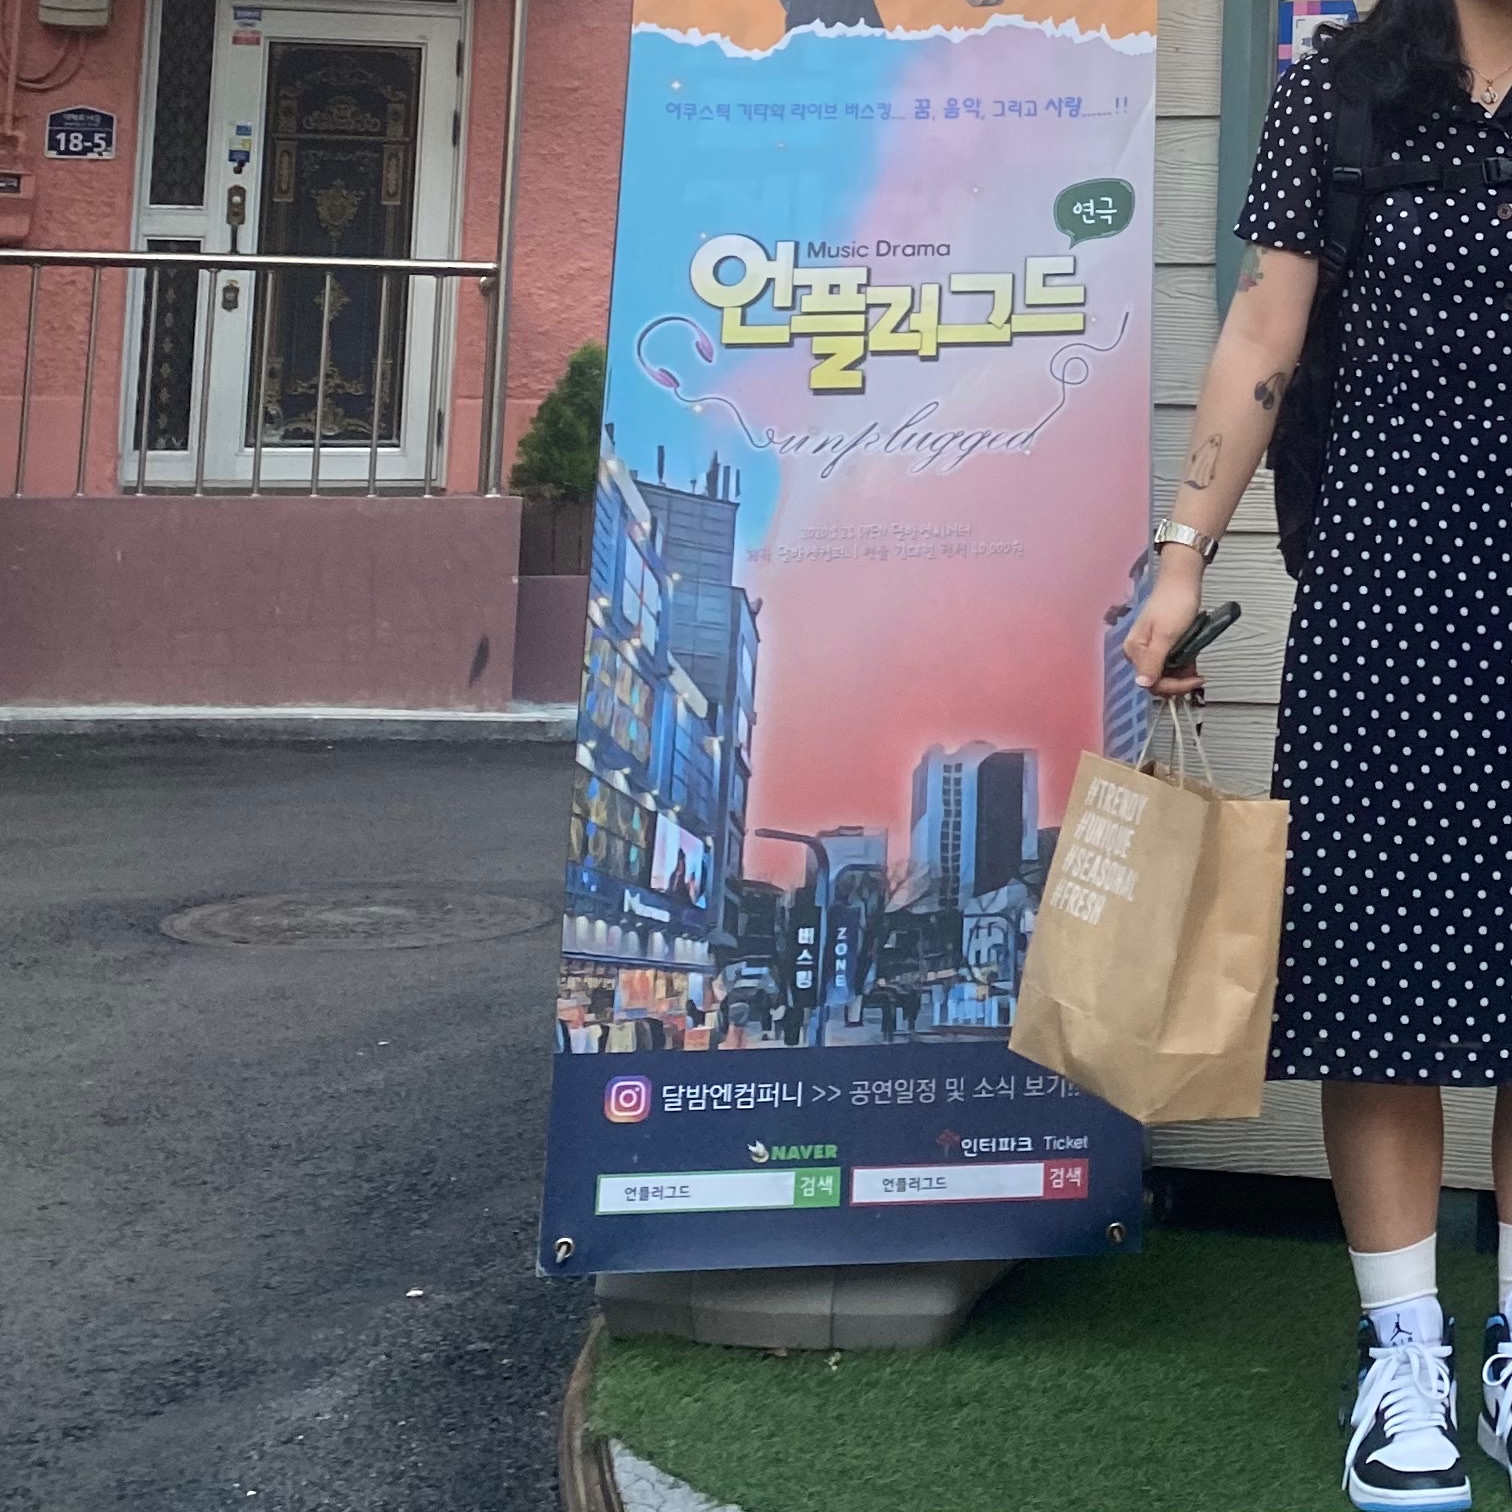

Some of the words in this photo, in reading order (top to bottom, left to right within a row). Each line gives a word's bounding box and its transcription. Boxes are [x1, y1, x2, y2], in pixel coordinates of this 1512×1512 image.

[665, 102, 731, 121] 어쿠스틱
[738, 102, 786, 121] 기타와
[790, 102, 838, 121] 라이브
[943, 97, 985, 121] 음악,
[992, 99, 1038, 119] 그리고
[56, 132, 107, 153] 18-5
[1072, 197, 1118, 225] 연극
[807, 240, 870, 258] Music
[875, 239, 951, 258] Drama
[690, 233, 1086, 393] 언플러그드
[766, 401, 1036, 478] unplugged
[796, 927, 815, 989] 버스킹
[834, 927, 848, 987] ZONE
[661, 1082, 803, 1112] 달밤엔컴퍼니
[849, 1078, 936, 1106] 공연일정
[945, 1076, 965, 1102] 및
[972, 1075, 1015, 1100] 소식
[771, 1143, 838, 1161] NAVER
[961, 1136, 1033, 1158] 인터파크
[1043, 1136, 1089, 1151] Ticket
[801, 1176, 833, 1198] 검색
[1050, 1167, 1082, 1189] 검색
